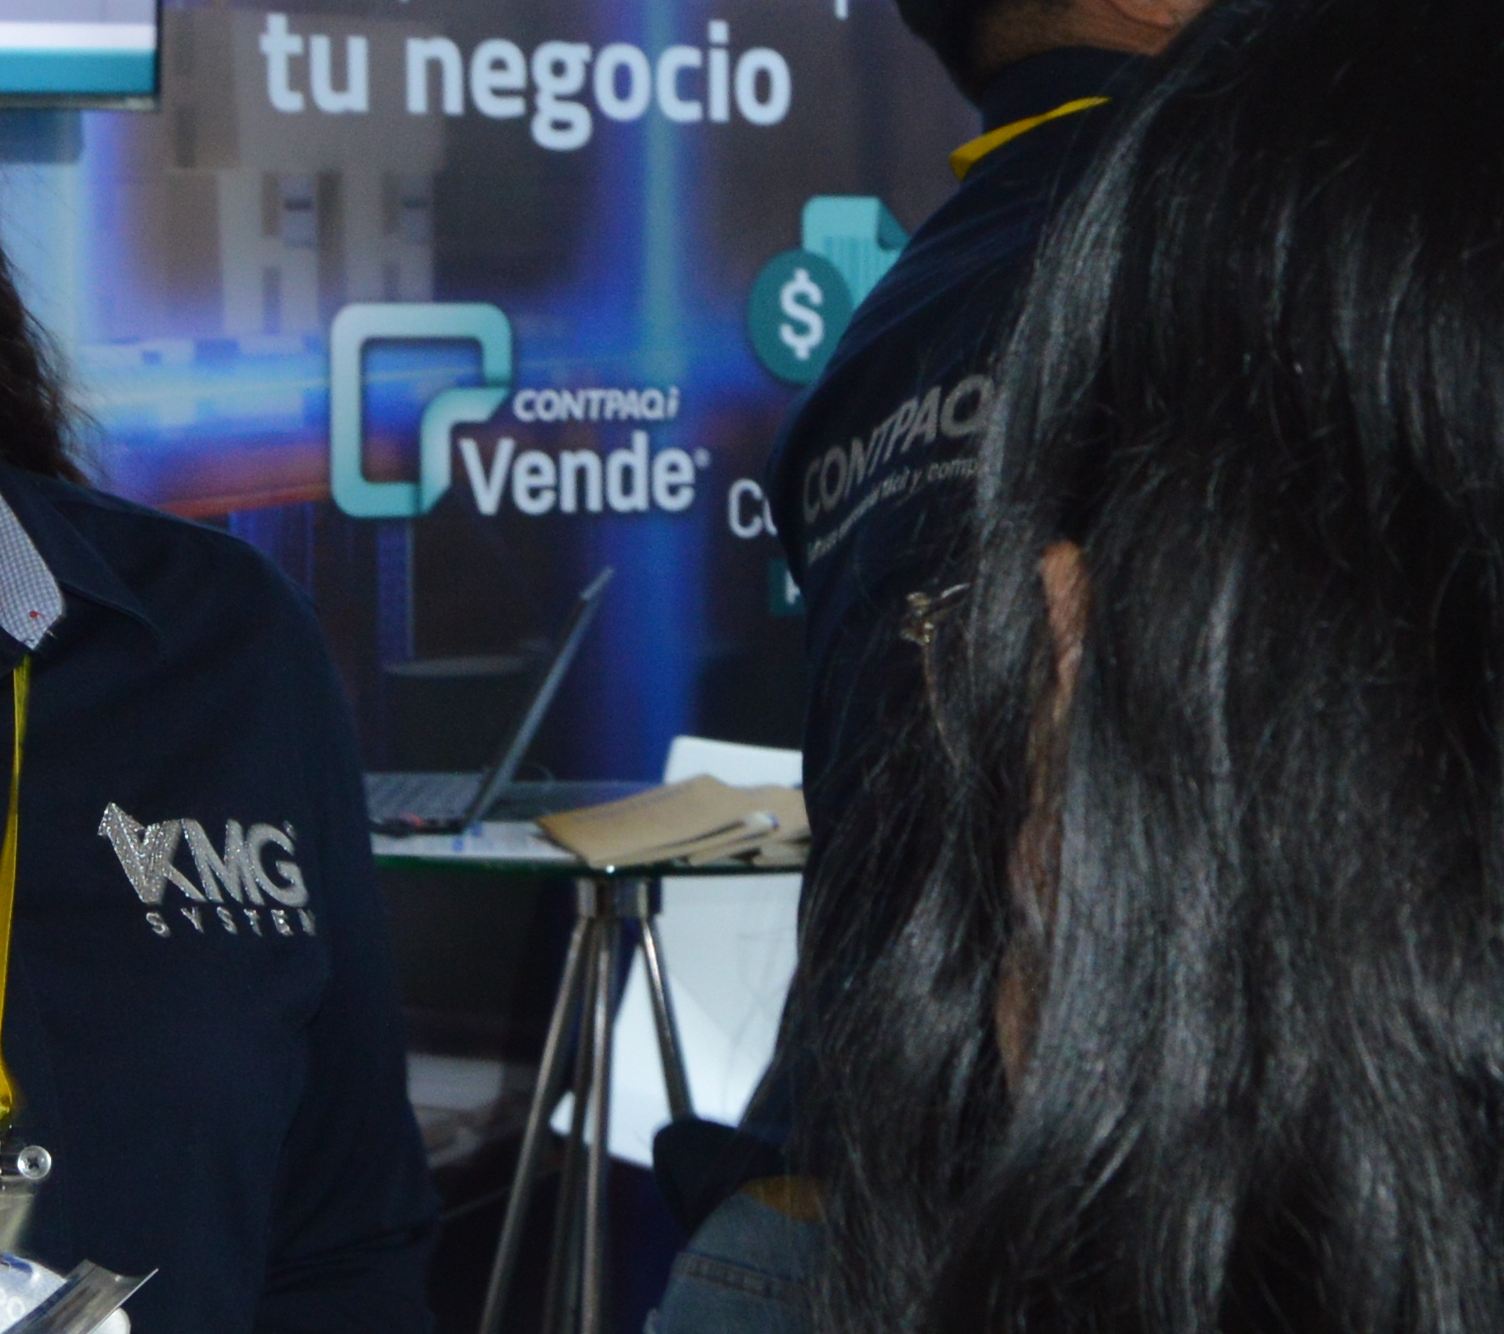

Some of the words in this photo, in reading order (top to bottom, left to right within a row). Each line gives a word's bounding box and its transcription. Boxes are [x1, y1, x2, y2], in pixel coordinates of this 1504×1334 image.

[260, 15, 368, 114] tu
[405, 22, 793, 149] negocio
[513, 385, 679, 422] CONTPAQi
[460, 434, 696, 516] Vende
